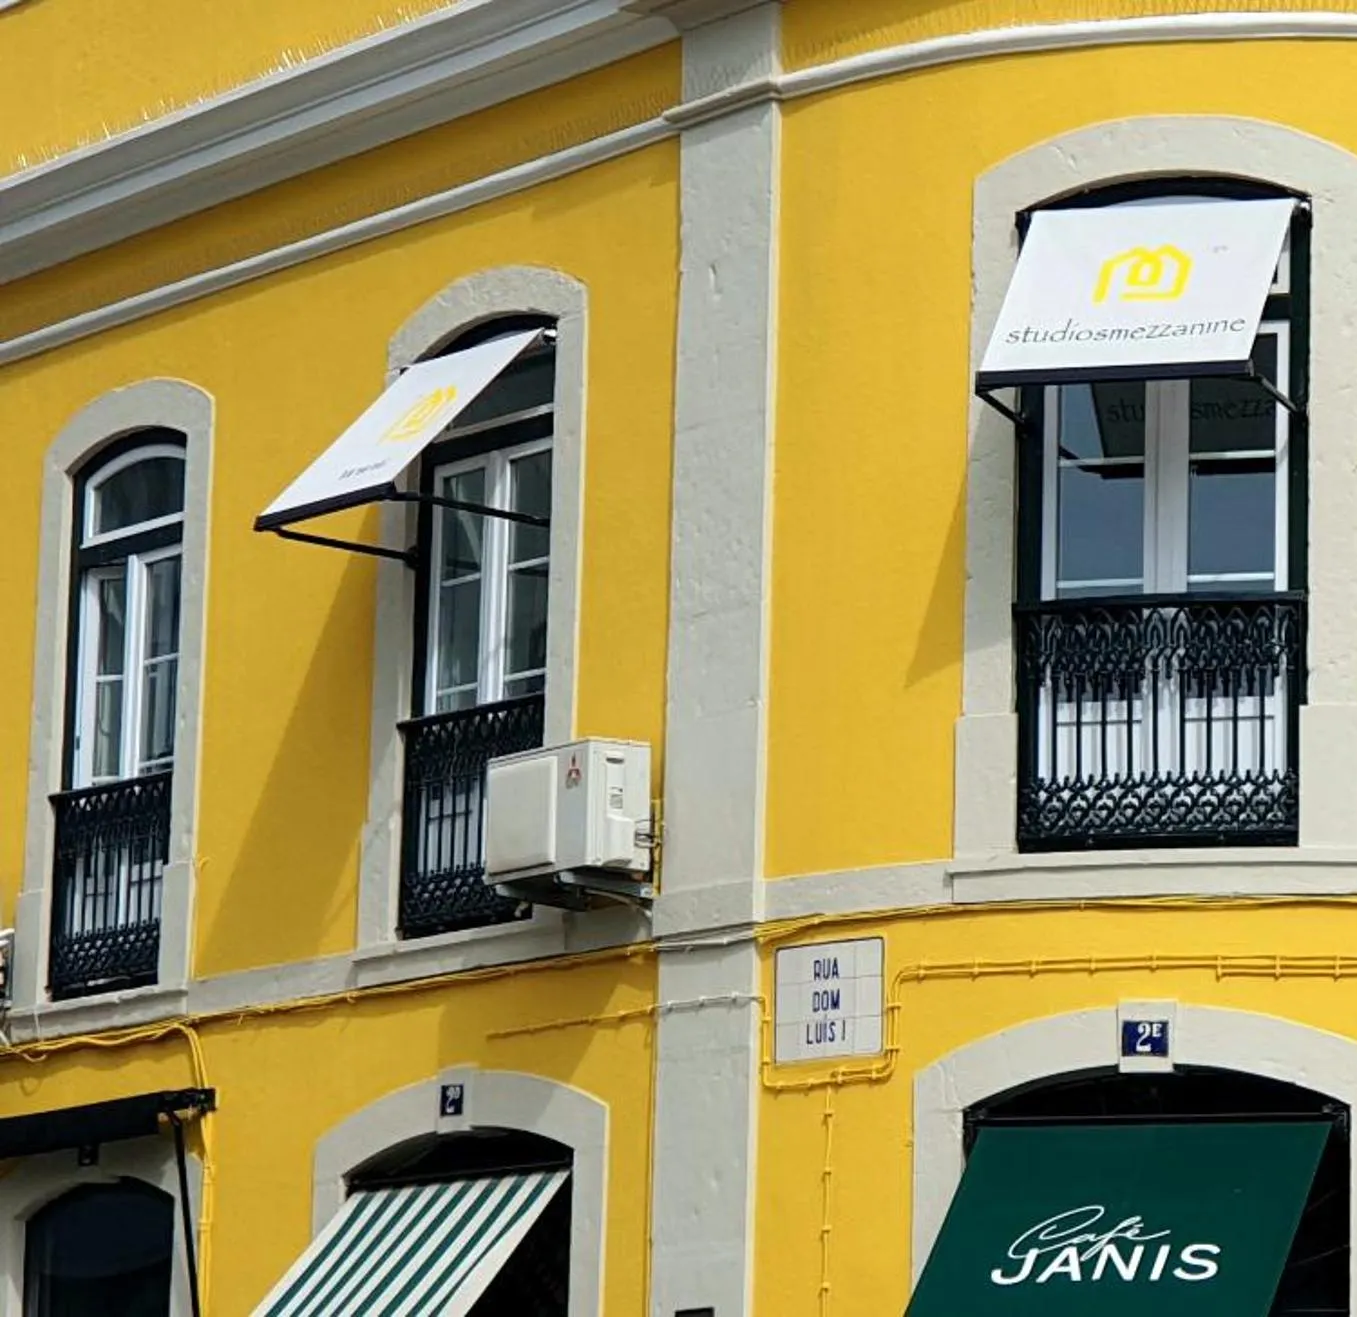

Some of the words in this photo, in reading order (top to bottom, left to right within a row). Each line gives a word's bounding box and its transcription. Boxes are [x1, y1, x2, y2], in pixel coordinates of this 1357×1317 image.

[1005, 317, 1247, 345] studiosmezzanine
[813, 957, 840, 981] RUA
[812, 988, 841, 1013] DOM
[1007, 1204, 1171, 1262] Café
[990, 1243, 1221, 1286] JANIS
